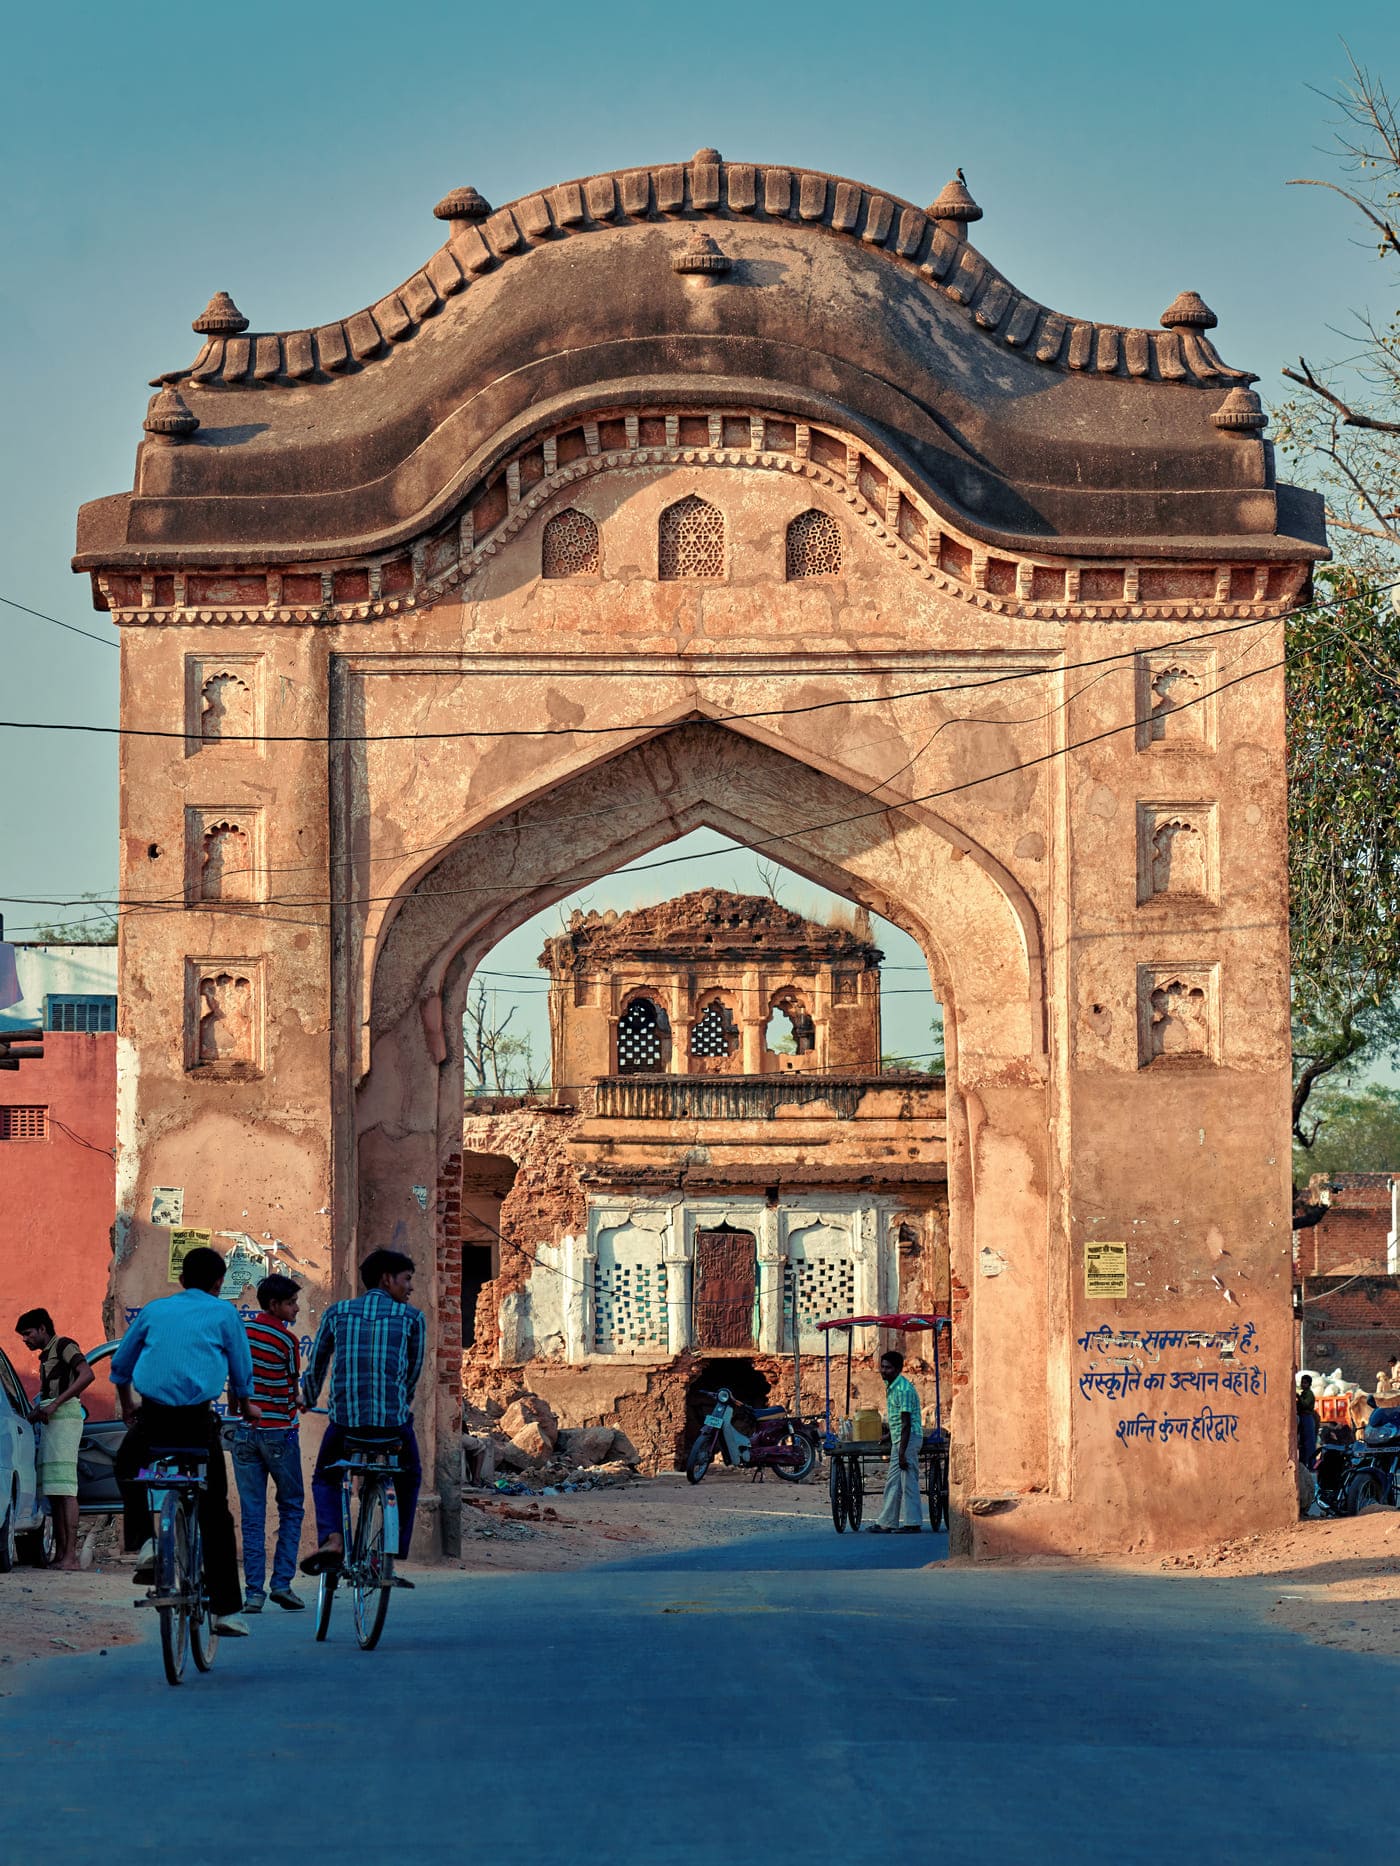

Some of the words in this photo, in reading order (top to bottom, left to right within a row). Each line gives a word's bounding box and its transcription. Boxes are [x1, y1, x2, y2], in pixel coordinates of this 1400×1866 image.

[1079, 1363, 1142, 1401] संस्कृति
[1143, 1373, 1167, 1391] का
[1169, 1371, 1219, 1392] उत्थान
[1222, 1363, 1248, 1396] वहाँ
[1158, 1411, 1191, 1442] कुंज
[1191, 1405, 1241, 1443] हरिद्वार
